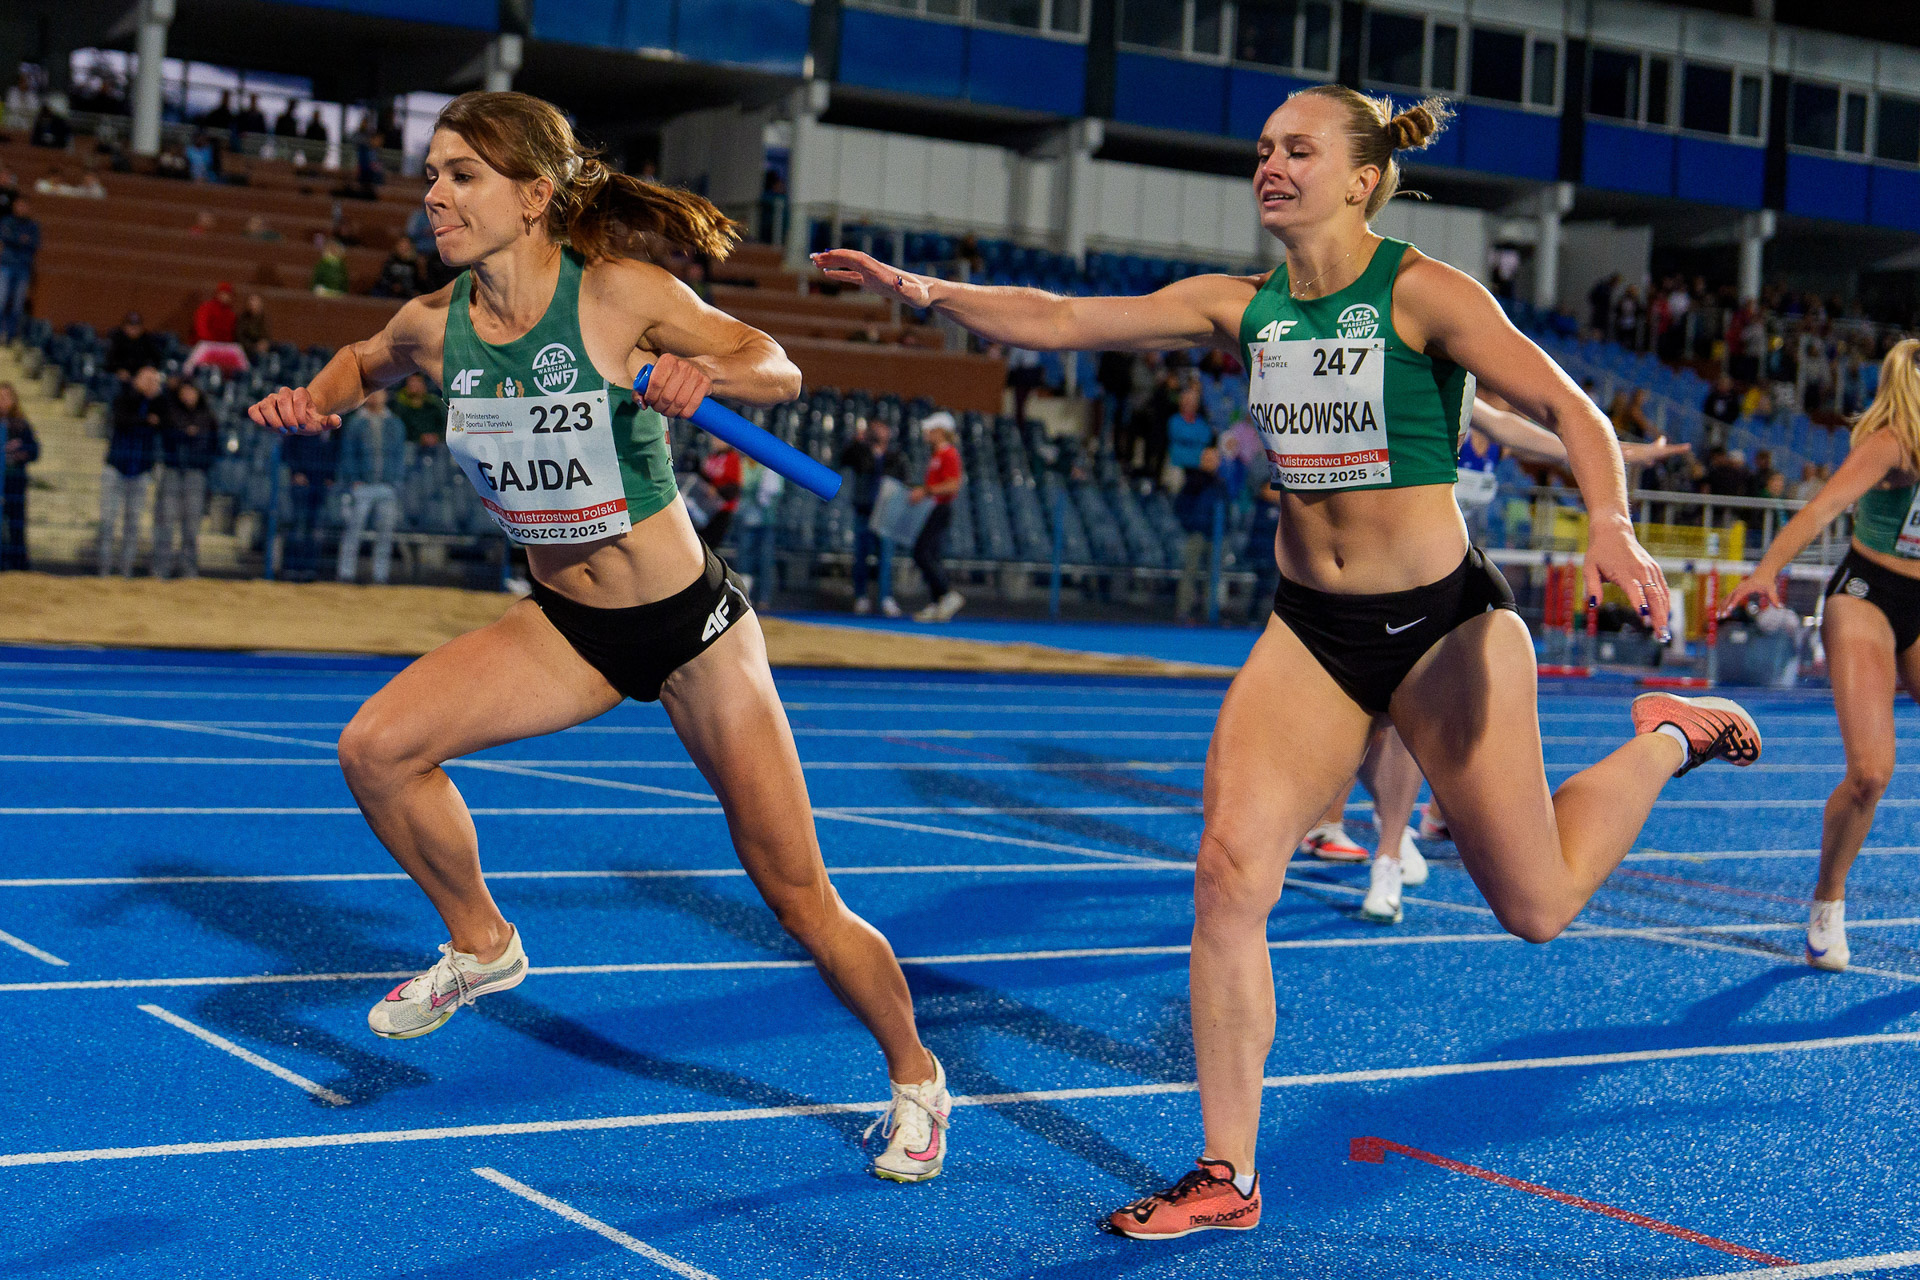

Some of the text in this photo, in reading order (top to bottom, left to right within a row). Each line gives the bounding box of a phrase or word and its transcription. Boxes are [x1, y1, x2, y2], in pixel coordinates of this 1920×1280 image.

[1342, 319, 1375, 328] WARSZAWA
[1347, 310, 1371, 321] AZS
[1256, 320, 1298, 342] 4F
[1344, 327, 1371, 338] AWF
[541, 350, 566, 366] AZS
[1313, 347, 1369, 376] 247
[537, 362, 573, 375] WARSZAWA
[451, 368, 484, 395] 4F
[542, 371, 571, 387] AWF
[487, 420, 513, 428] Turystyki
[529, 402, 593, 434] 223
[1282, 456, 1341, 467] Mistrzostwa
[1344, 450, 1379, 465] Polski
[478, 458, 593, 492] GAJDA
[1329, 469, 1367, 483] 2025
[514, 501, 617, 523] Mistrzostwa Polski
[569, 521, 607, 539] 2025
[701, 594, 730, 642] 4F
[1189, 1198, 1259, 1225] new balance
